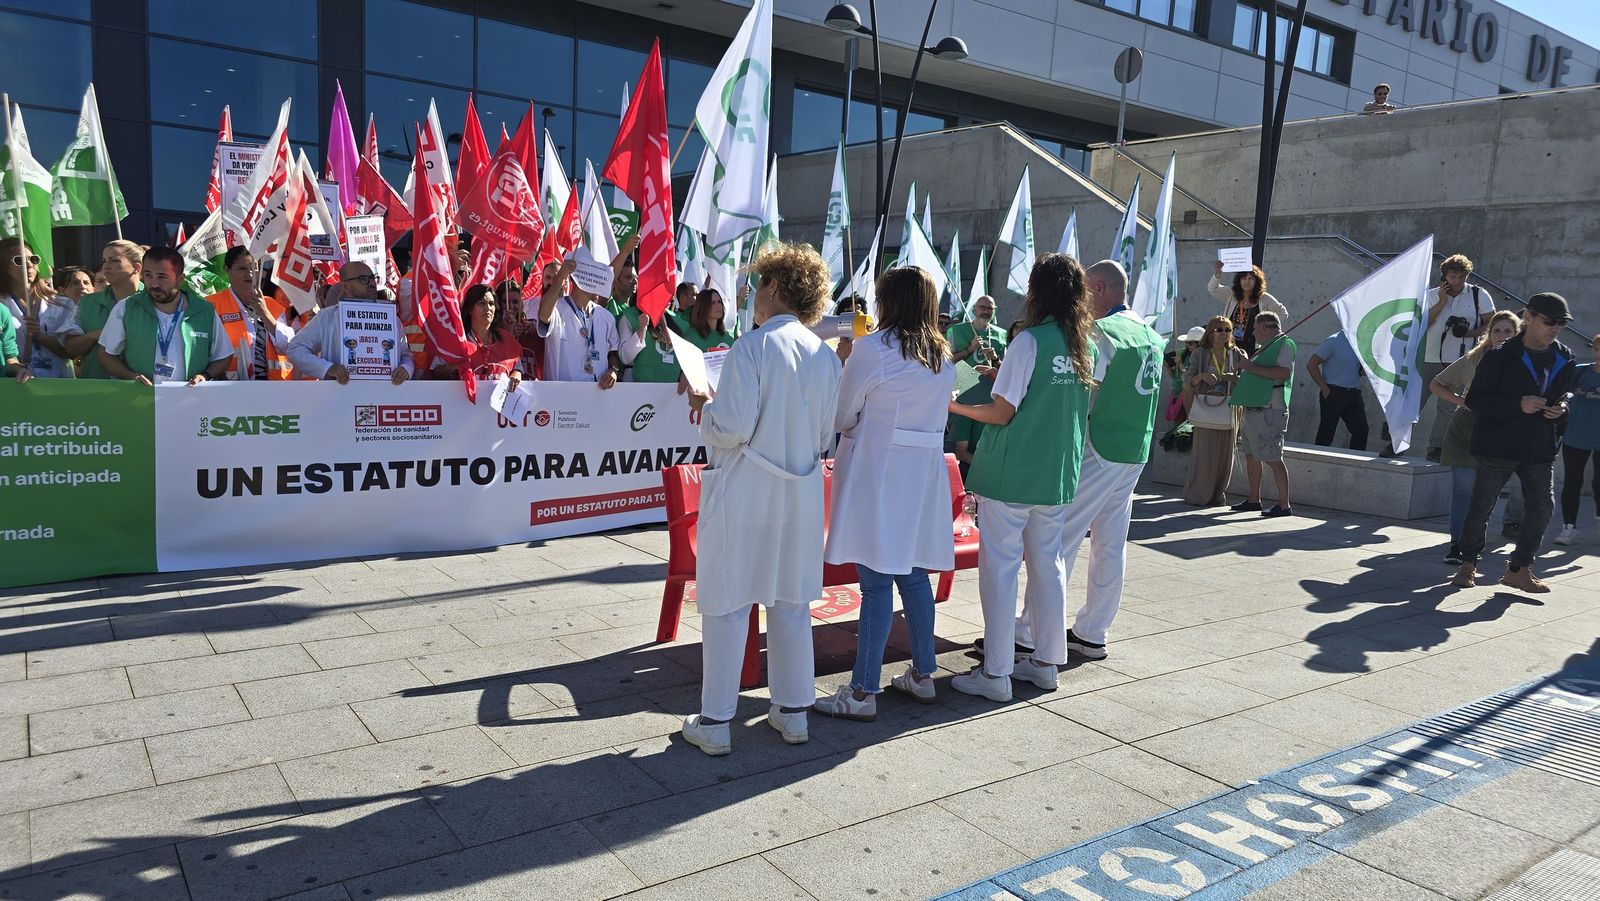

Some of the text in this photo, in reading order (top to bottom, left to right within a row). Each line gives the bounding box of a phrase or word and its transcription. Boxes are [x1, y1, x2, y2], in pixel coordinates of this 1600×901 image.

[1330, 0, 1573, 89] ARIO DE
[230, 152, 236, 160] EL
[350, 226, 360, 234] POR
[374, 234, 380, 242] DE
[357, 245, 378, 254] JORNADA
[347, 310, 388, 320] UN ESTATUTO
[346, 322, 392, 332] PARA AVANZAR
[1052, 356, 1076, 374] SA
[383, 409, 438, 422] CCOO
[498, 410, 532, 428] UT
[0, 422, 100, 437] sificación
[197, 417, 208, 438] fses
[210, 414, 300, 436] SATSE
[24, 441, 124, 456] retribuida
[15, 469, 121, 486] anticipada
[196, 466, 263, 499] UN
[277, 456, 496, 494] ESTATUTO
[504, 452, 590, 483] PARA
[683, 465, 702, 484] N
[537, 508, 557, 518] POR
[559, 506, 574, 515] UN
[576, 498, 627, 513] ESTATUTO
[628, 494, 652, 506] PARA
